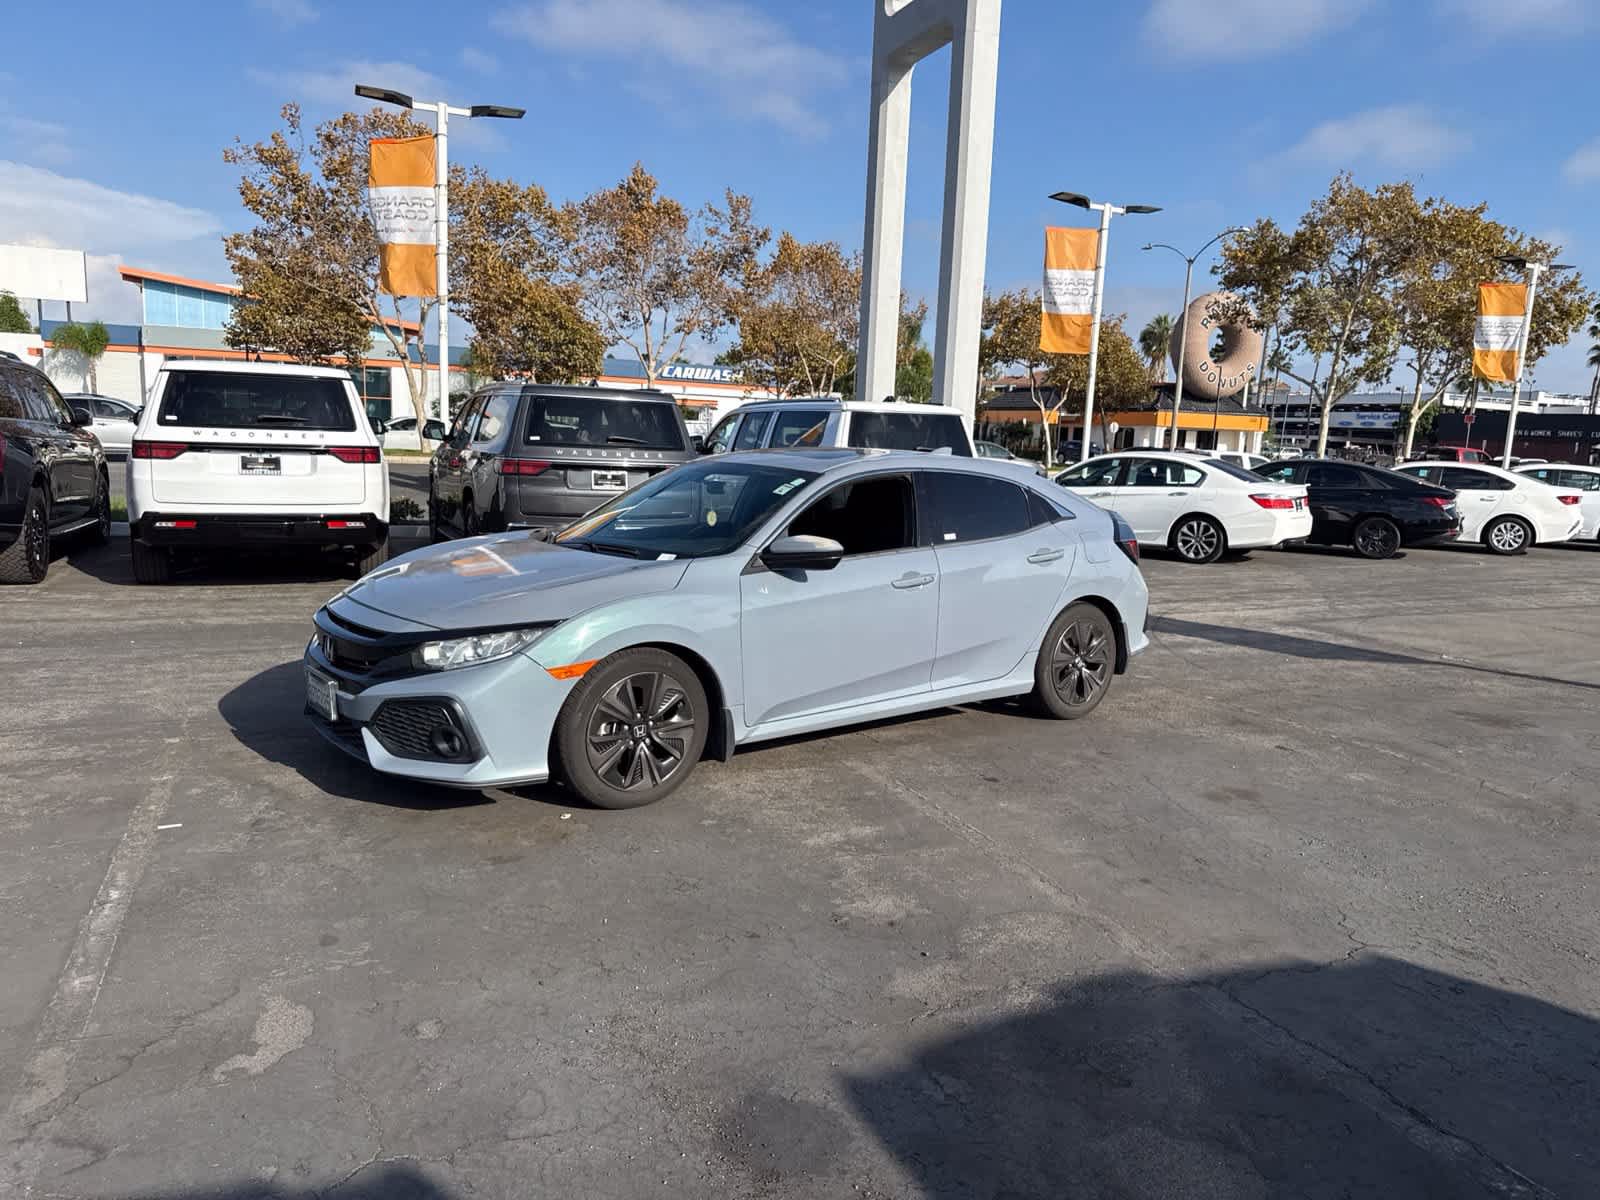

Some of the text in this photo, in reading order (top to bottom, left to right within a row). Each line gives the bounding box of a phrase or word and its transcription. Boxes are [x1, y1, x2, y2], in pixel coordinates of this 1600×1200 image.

[1199, 361, 1255, 388] DONUTS
[193, 429, 325, 440] WAGONEER
[556, 449, 663, 459] WAGONEER
